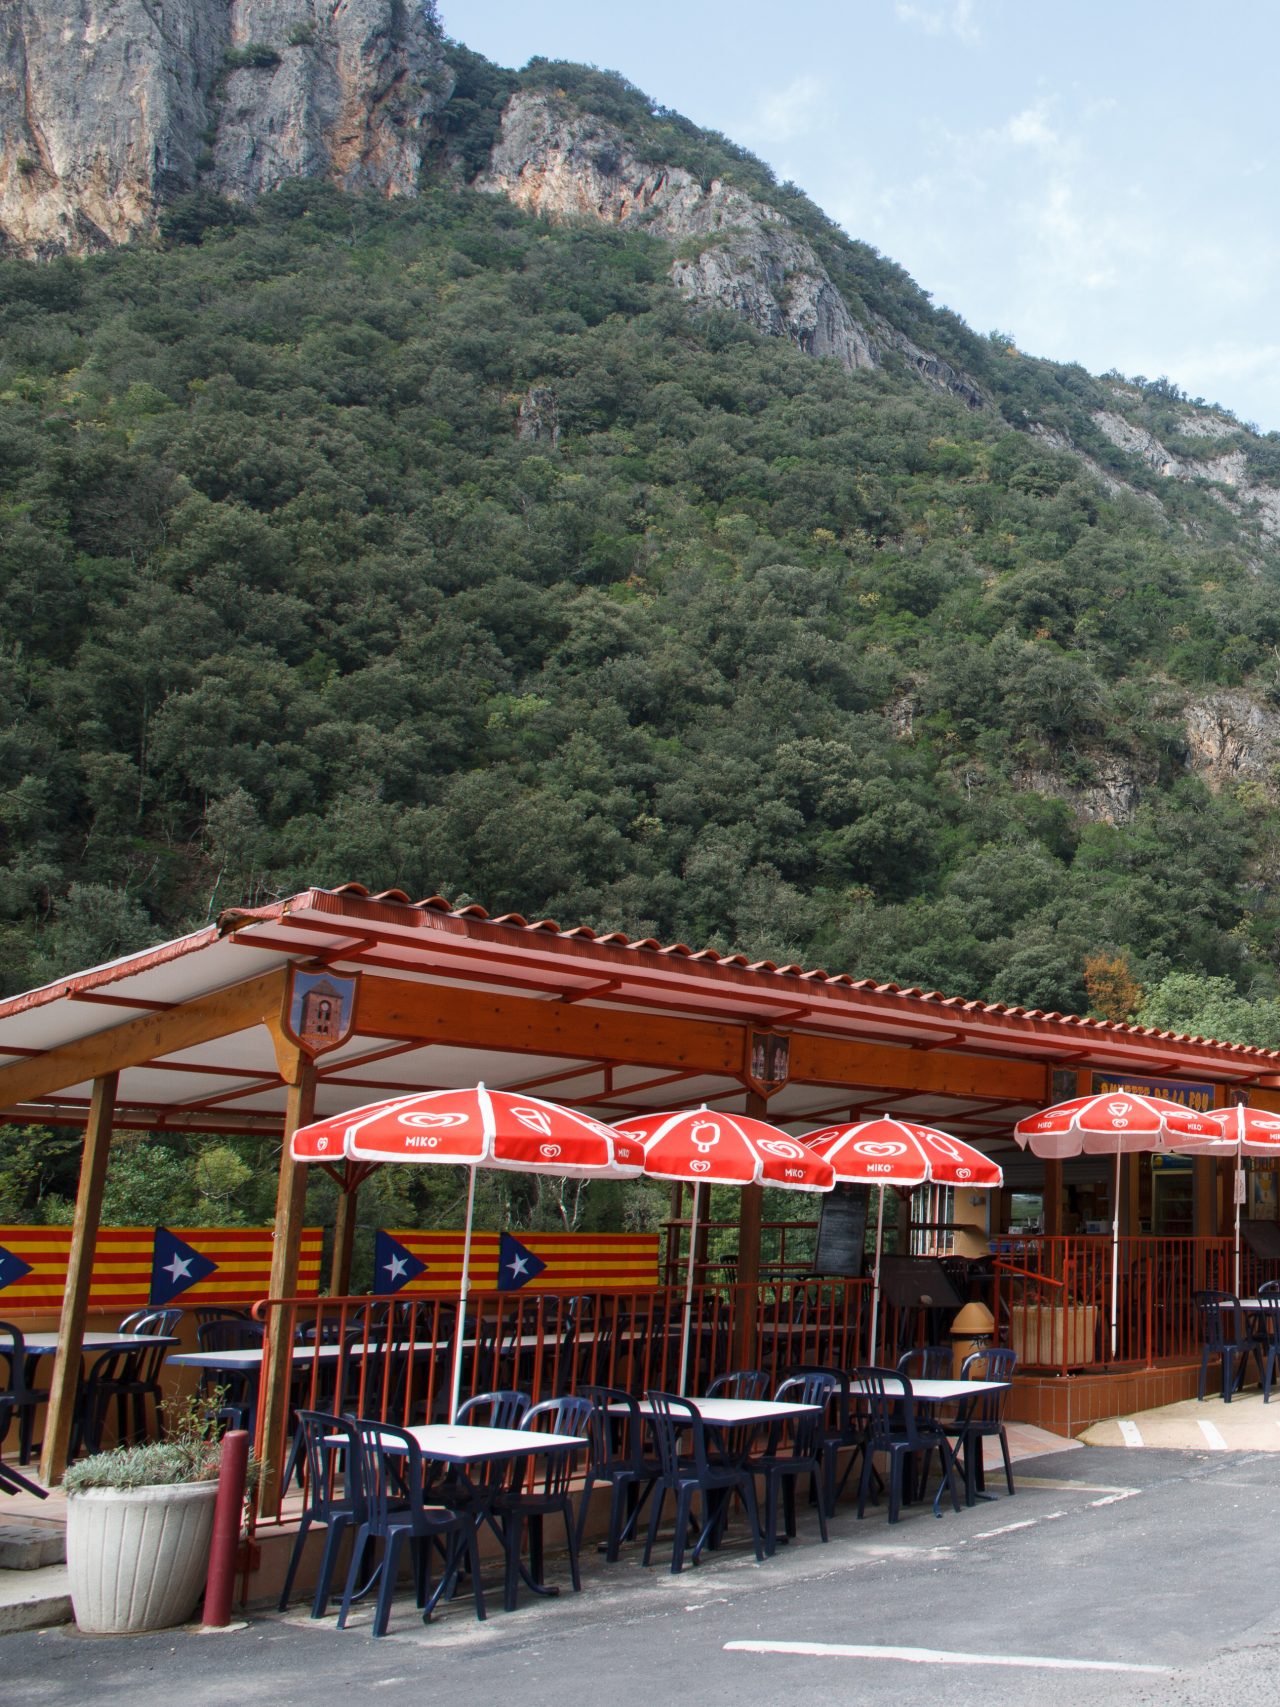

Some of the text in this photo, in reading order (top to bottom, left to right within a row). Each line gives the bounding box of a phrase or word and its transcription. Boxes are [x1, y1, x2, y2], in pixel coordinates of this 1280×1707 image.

[405, 1136, 438, 1147] MIKO
[867, 1163, 891, 1172] MIKO
[785, 1168, 803, 1178] MIKO
